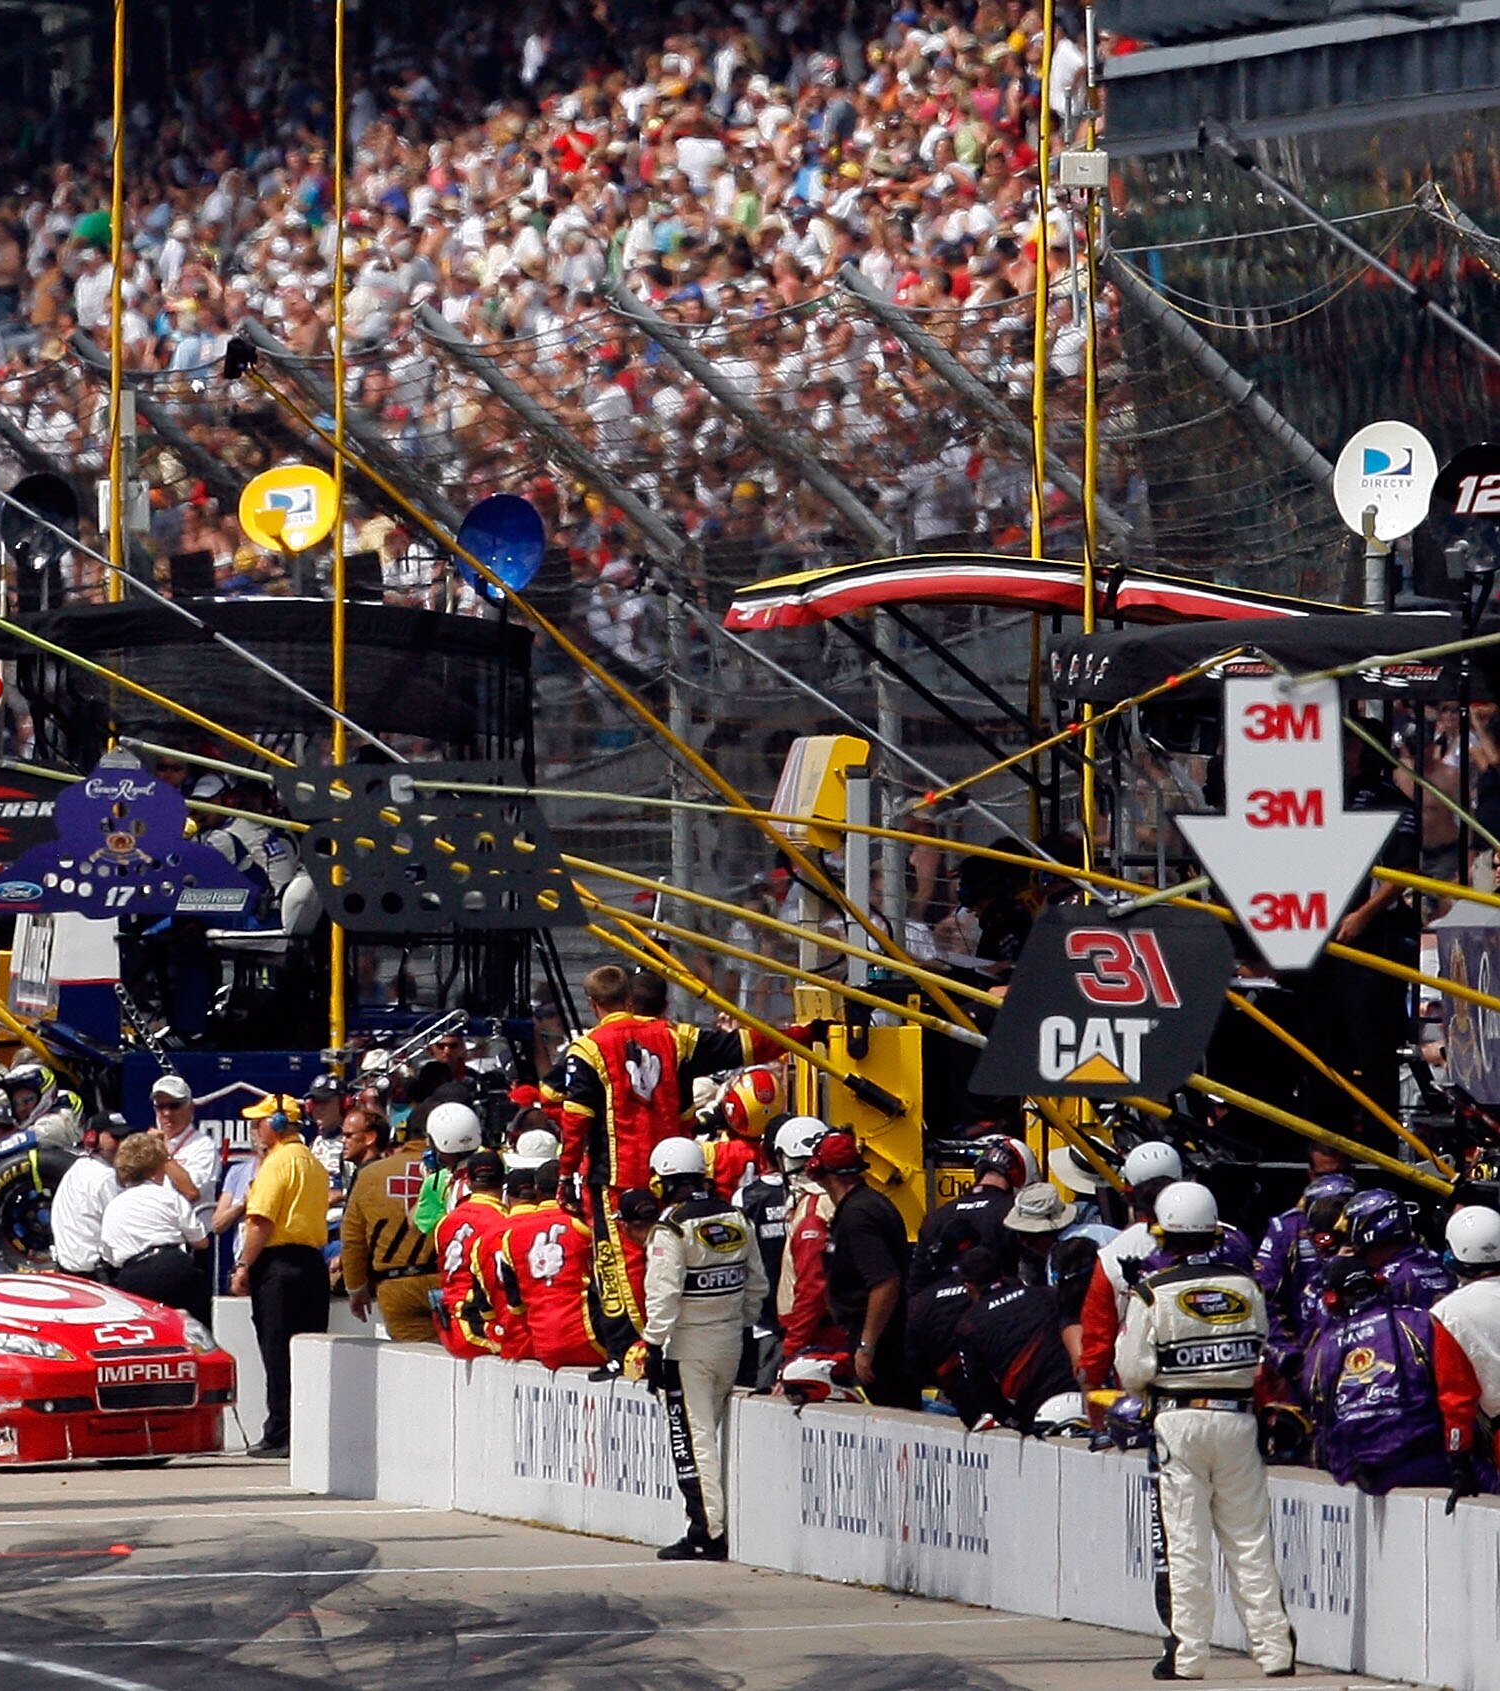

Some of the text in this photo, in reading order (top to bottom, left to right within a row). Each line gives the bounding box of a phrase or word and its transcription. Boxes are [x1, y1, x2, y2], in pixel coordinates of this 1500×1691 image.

[1361, 479, 1414, 488] DIRECTV
[1455, 474, 1500, 514] 12
[1242, 704, 1322, 742] 3M
[1245, 789, 1324, 828] 3M
[104, 886, 136, 907] 17
[1249, 893, 1328, 933] 3M
[1065, 929, 1182, 1009] 31
[1039, 1017, 1152, 1083] CAT
[597, 1240, 625, 1318] Cheerios
[697, 1268, 746, 1289] OFFICIA
[97, 1361, 197, 1383] IMPALA
[1176, 1341, 1257, 1366] OFFICIAL
[669, 1404, 688, 1458] Sprint
